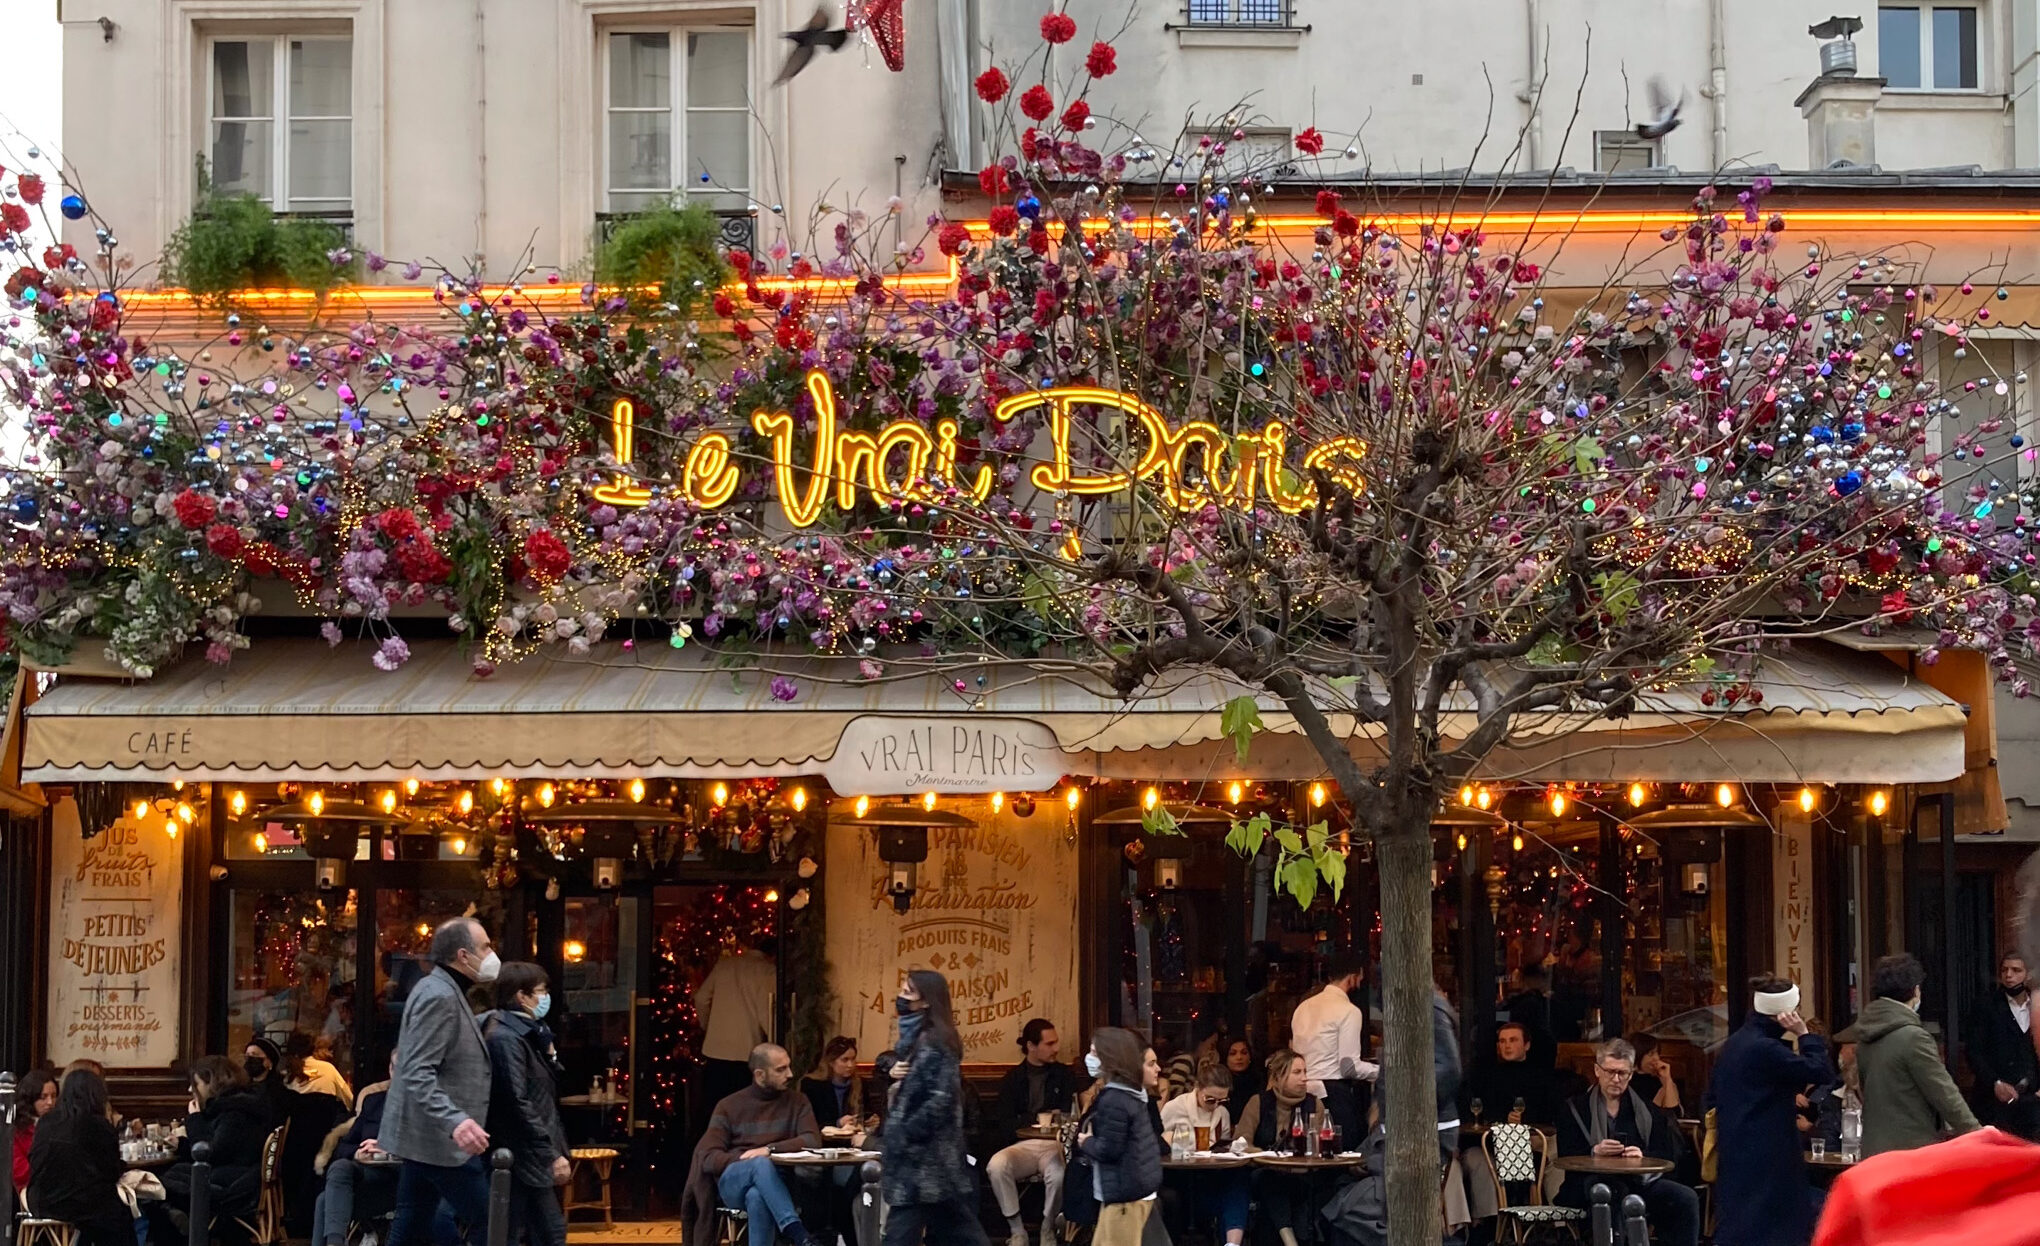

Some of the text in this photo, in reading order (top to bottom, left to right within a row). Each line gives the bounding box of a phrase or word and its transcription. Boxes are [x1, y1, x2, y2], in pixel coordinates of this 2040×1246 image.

[593, 367, 1368, 528] Le Vrai Paris
[128, 728, 192, 754] CAFÉ
[861, 726, 1036, 777] VRAI PARIS
[905, 773, 988, 787] Montmartre
[97, 827, 138, 852] JUS
[933, 825, 1032, 871] PARISIEN
[75, 846, 158, 882] fruits
[92, 872, 142, 888] FRAIS
[1787, 838, 1802, 985] BIENVEN
[83, 914, 146, 937] PETITS
[898, 929, 1012, 957] PRODUITS FRAIS
[63, 938, 166, 977] DÉJEUNERS
[948, 952, 961, 970] &
[83, 1005, 146, 1021] DESSERTS
[967, 990, 1034, 1026] HEURE
[67, 1019, 162, 1038] gourmands
